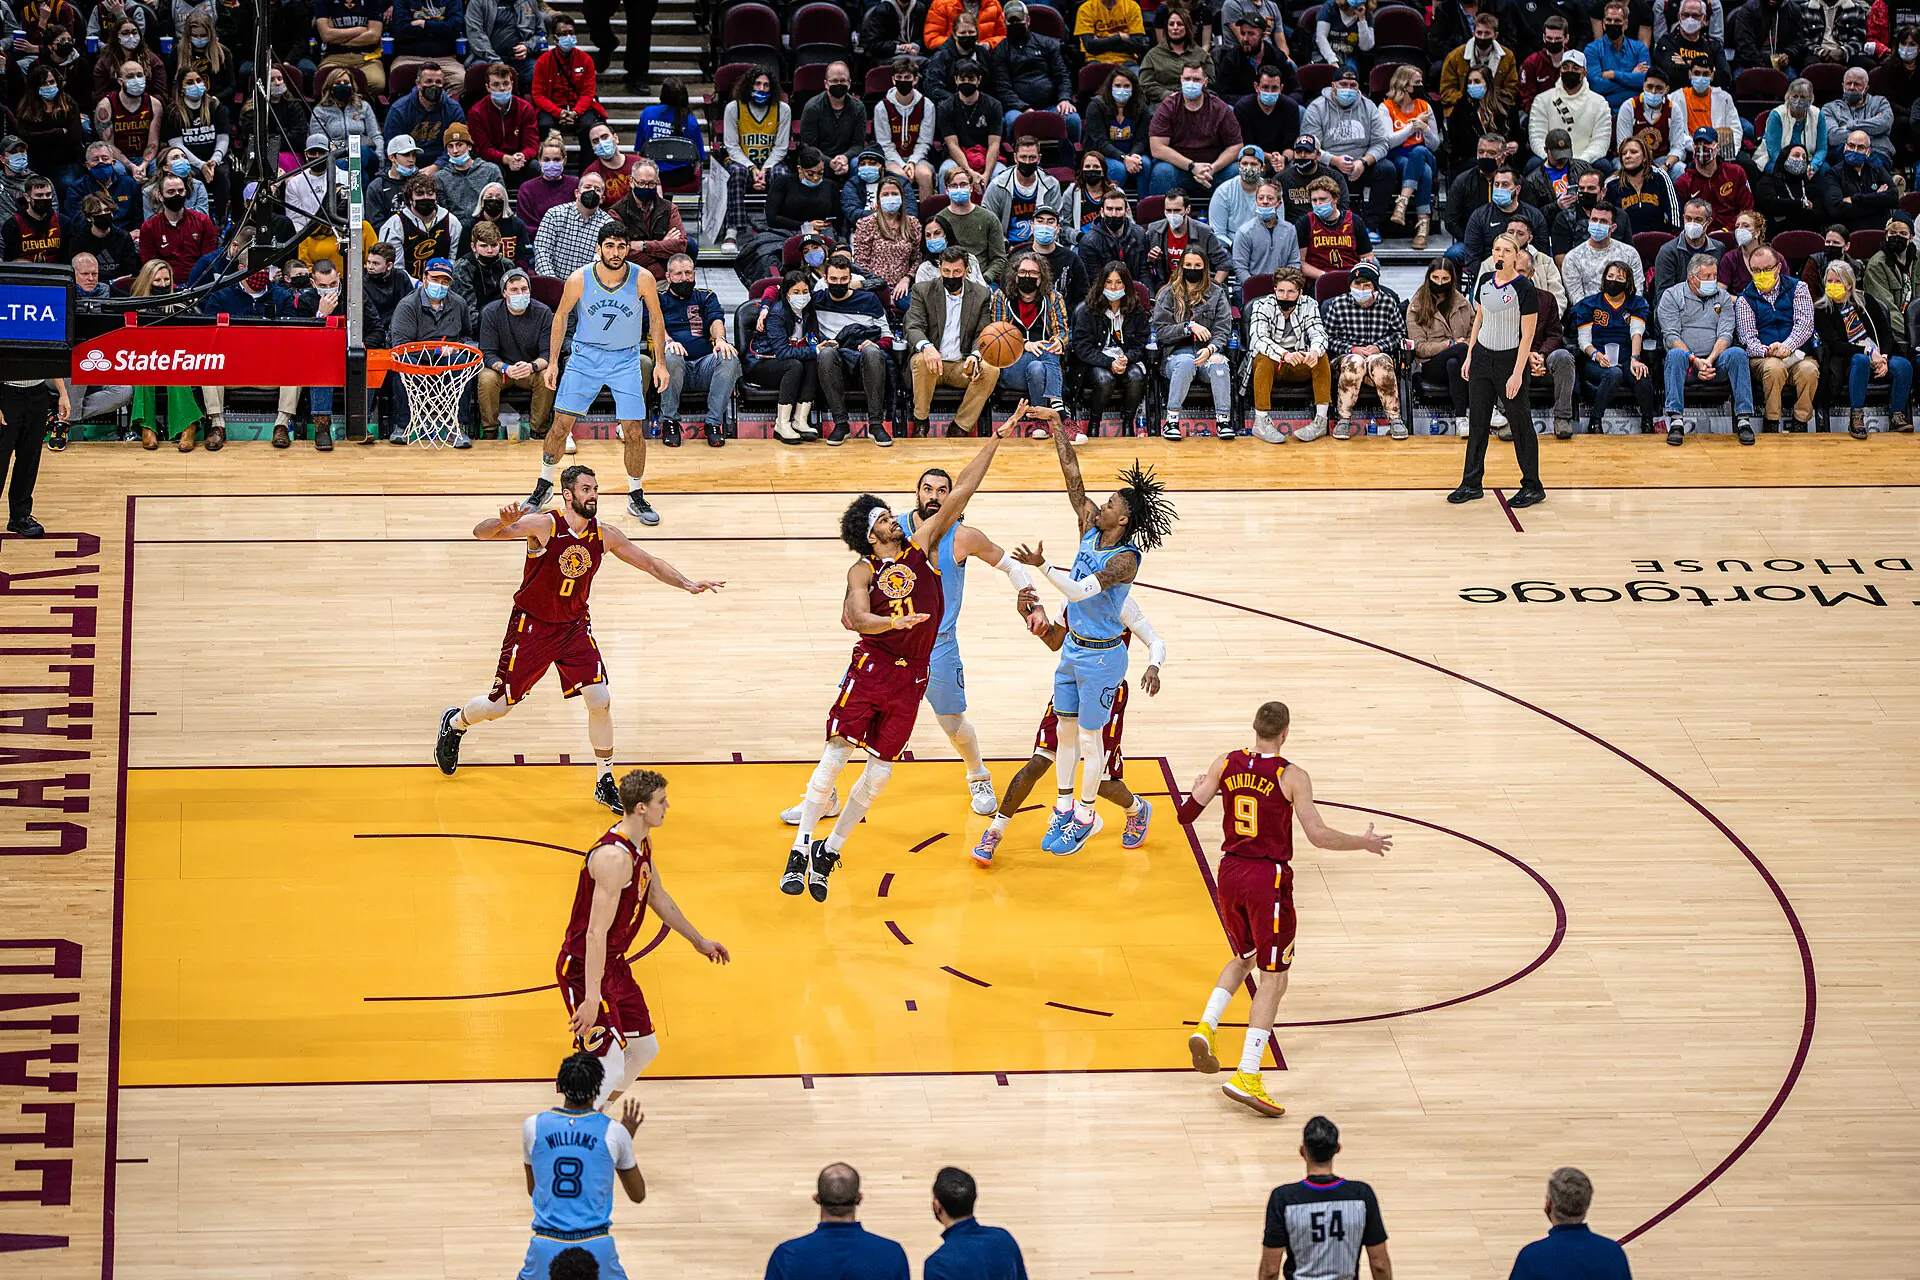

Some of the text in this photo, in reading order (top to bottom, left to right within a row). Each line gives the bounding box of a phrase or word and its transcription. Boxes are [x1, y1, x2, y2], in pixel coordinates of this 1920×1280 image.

[184, 133, 216, 143] KNOW
[742, 134, 776, 146] IRISH
[748, 149, 768, 161] 23
[1312, 236, 1352, 248] CLEVELAND
[587, 298, 634, 318] GRIZZLIES
[1594, 308, 1610, 326] 23
[602, 312, 618, 331] 7
[248, 425, 264, 440] 7
[591, 425, 610, 440] 11
[1631, 558, 1914, 575] DHOUSE
[560, 578, 576, 597] 0
[1458, 581, 1889, 607] Mortgage
[888, 597, 915, 618] 31
[1224, 773, 1276, 798] WINDLER
[1234, 795, 1258, 838] 9
[545, 1131, 598, 1152] WILLIAMS
[551, 1156, 584, 1199] 8
[1310, 1209, 1345, 1242] 54
